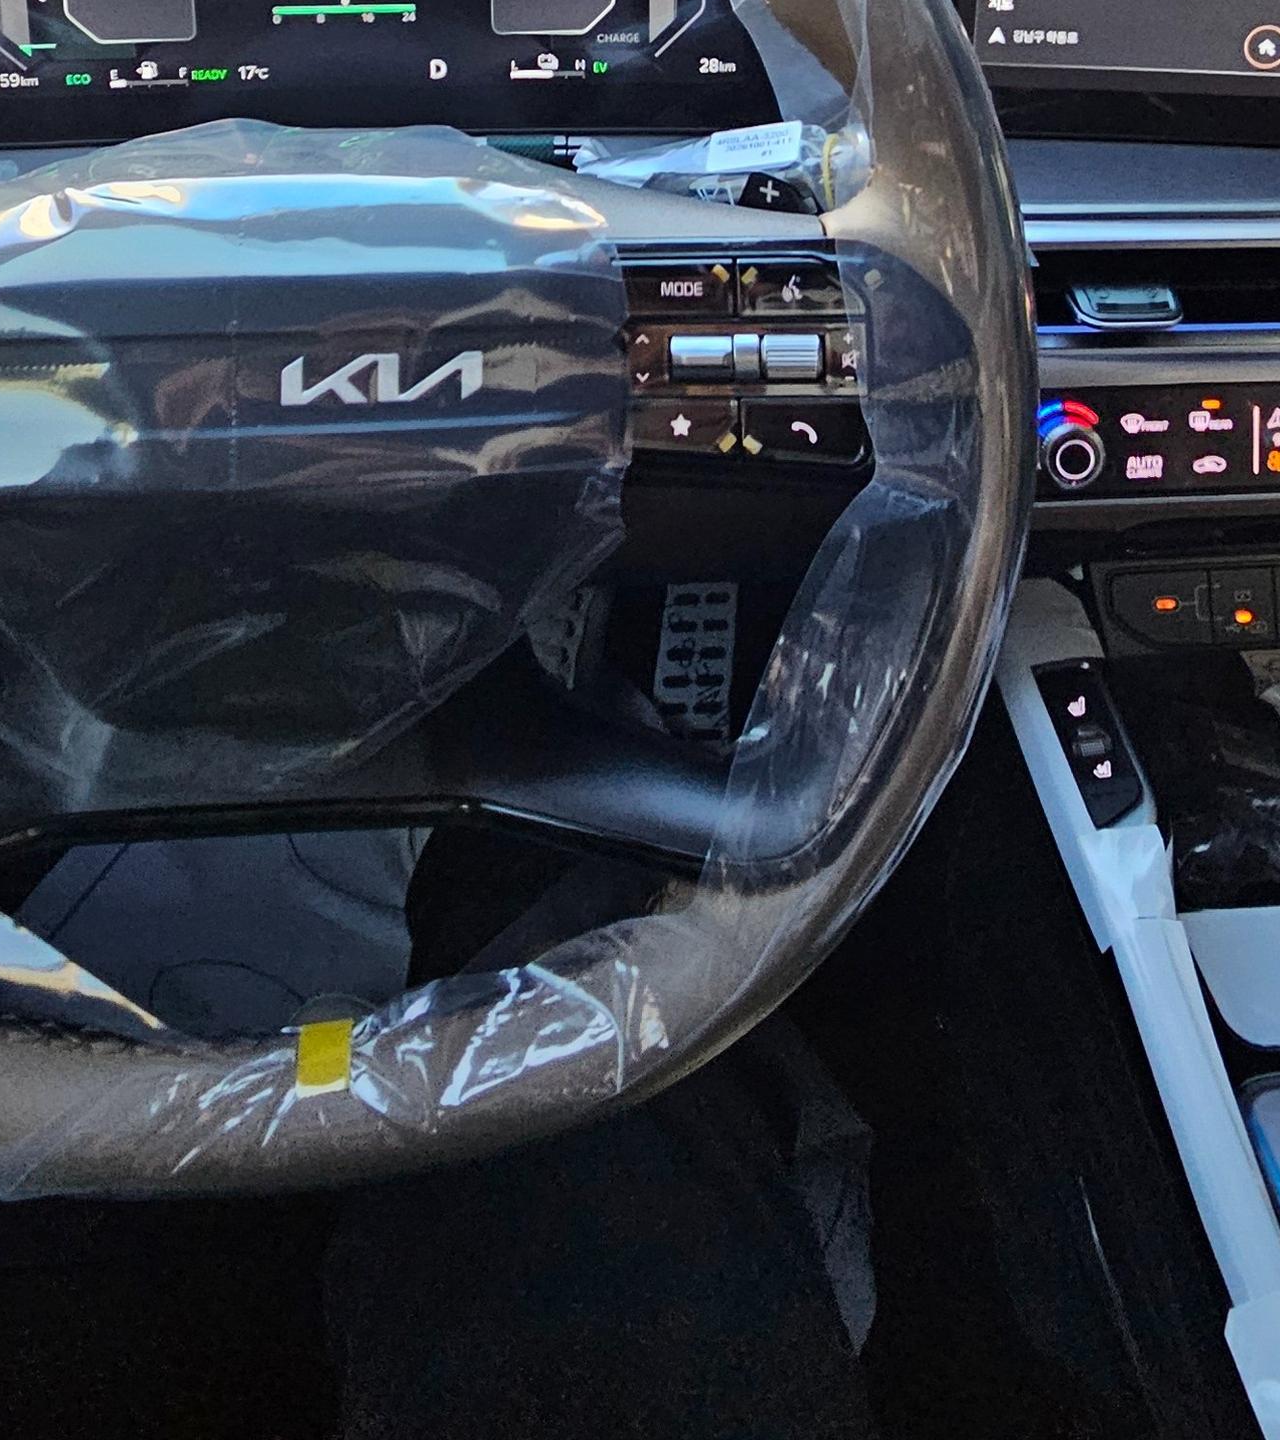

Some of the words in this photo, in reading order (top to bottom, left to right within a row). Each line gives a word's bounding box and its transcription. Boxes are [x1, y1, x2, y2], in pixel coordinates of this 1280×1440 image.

[272, 14, 282, 24] 0
[402, 12, 416, 22] 24
[597, 33, 640, 44] CHARGE
[429, 59, 448, 80] D
[593, 61, 608, 74] EV
[66, 74, 91, 85] ECO
[191, 69, 227, 81] READY
[660, 281, 703, 297] MODE
[280, 351, 483, 406] KIA
